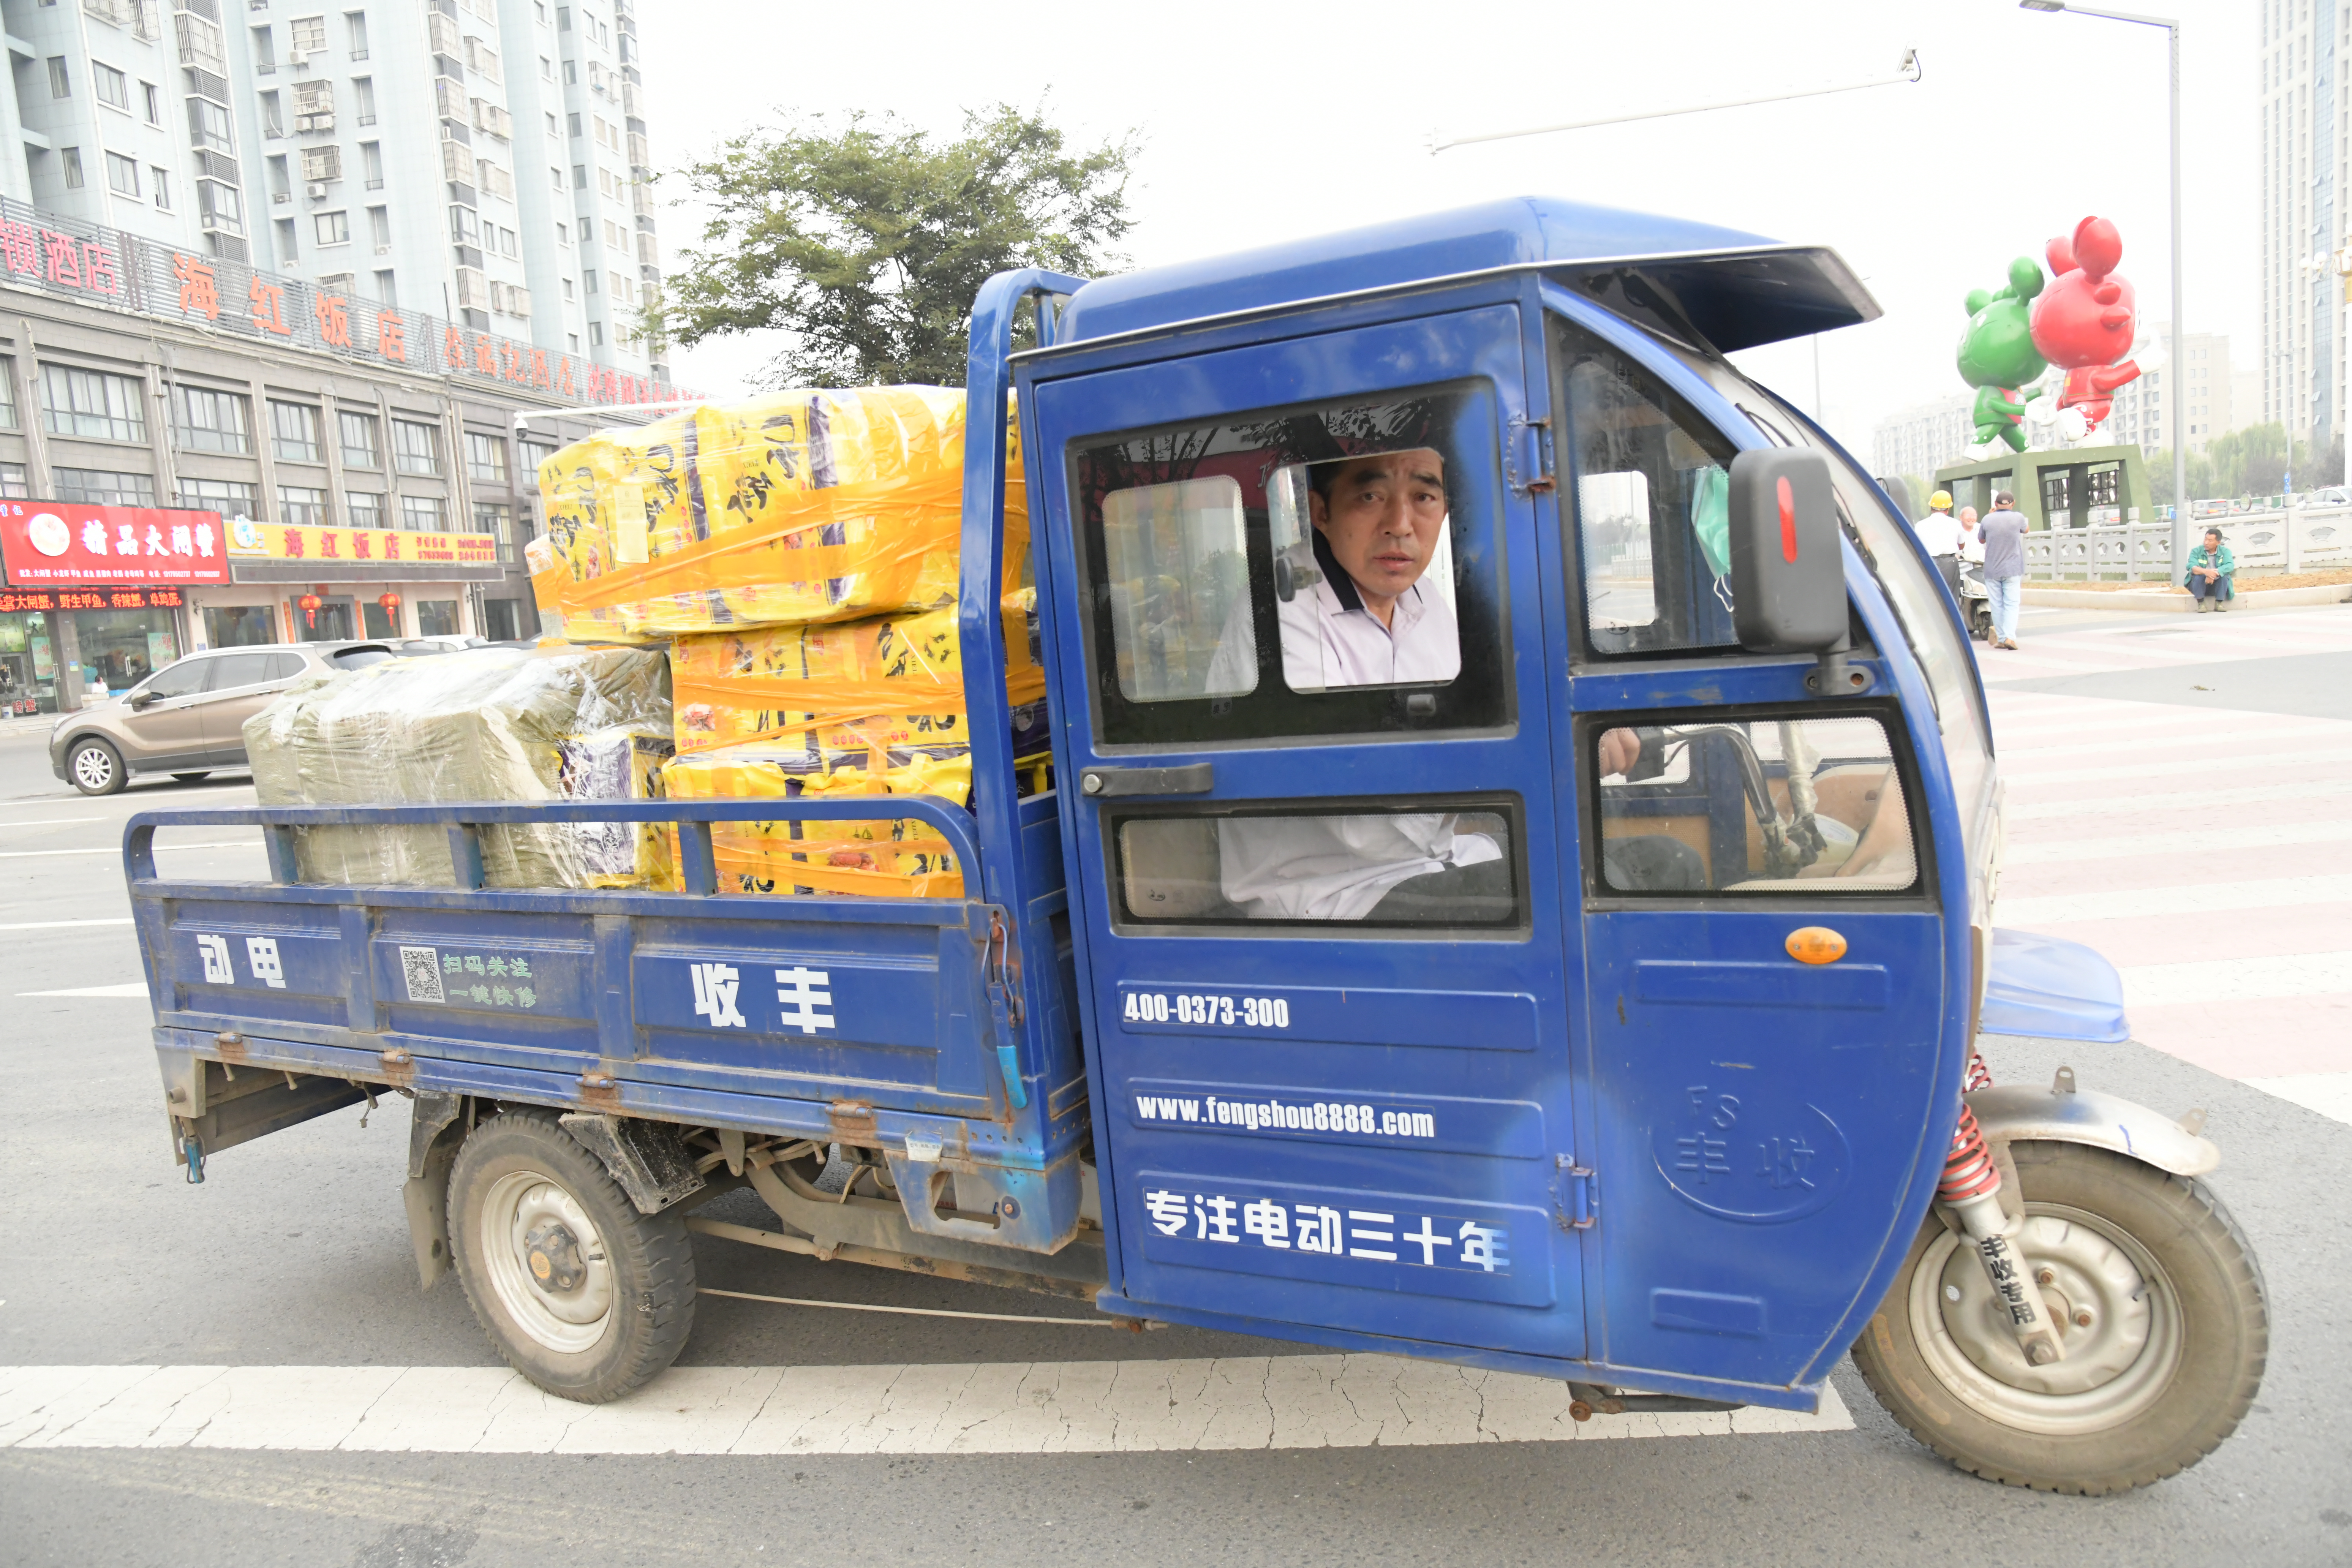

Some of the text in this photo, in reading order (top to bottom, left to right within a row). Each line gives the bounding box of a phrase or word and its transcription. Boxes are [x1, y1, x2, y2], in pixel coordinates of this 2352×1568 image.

[173, 253, 405, 363] 海红饭店
[443, 326, 575, 397] 徐福记酒店
[82, 519, 215, 558] 精品大闸蟹
[284, 528, 400, 560] 海红饭店
[443, 953, 532, 978] 扫码关注
[449, 984, 537, 1008] 一键快修
[1124, 993, 1289, 1028] 400-0373-300
[1136, 1095, 1435, 1138] www.fengshou8888.com
[1146, 1190, 1510, 1272] 专注电动三十年
[1980, 1233, 2036, 1325] 丰收专用
